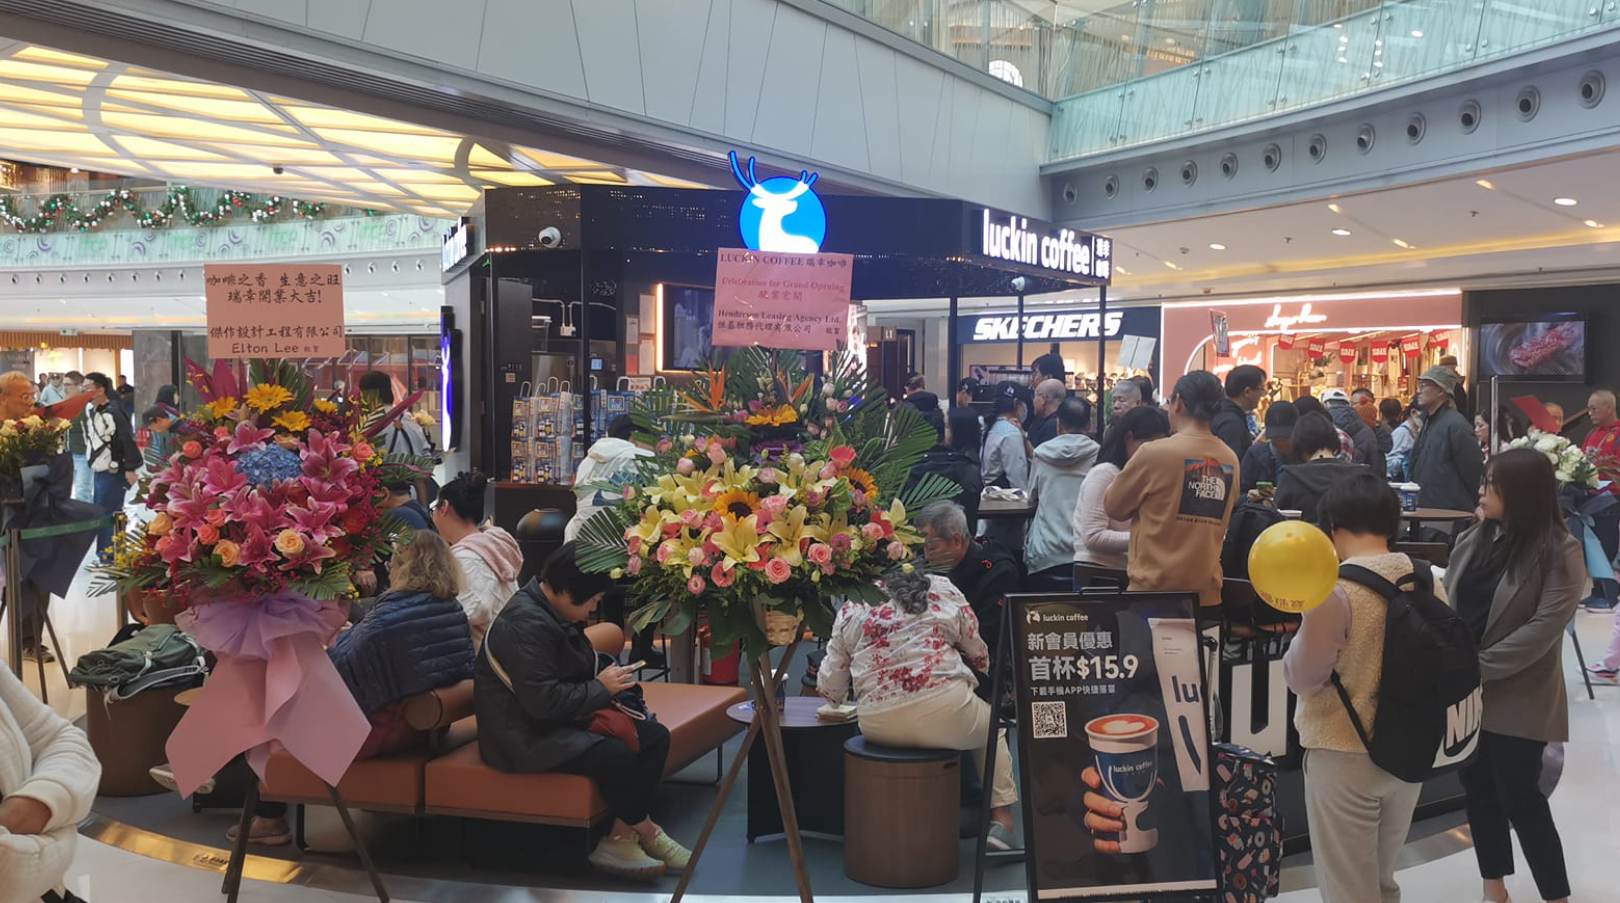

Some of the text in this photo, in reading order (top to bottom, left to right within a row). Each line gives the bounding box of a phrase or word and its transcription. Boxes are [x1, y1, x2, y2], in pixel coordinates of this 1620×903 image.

[983, 208, 1090, 275] luckin coffee
[762, 256, 805, 267] COFFEE
[206, 272, 341, 287] 咖啡之香 生意之旺
[769, 279, 782, 288] for
[782, 280, 809, 290] Grand
[810, 282, 846, 294] Opening
[227, 288, 323, 304] 瑞幸開業大吉!
[718, 309, 842, 325] Henderson Leasing Agency Ltd.
[210, 325, 343, 340] 傑作設計工程有限公司
[973, 312, 1124, 341] SKECHERS
[231, 343, 268, 354] Elton
[274, 343, 300, 354] Lee
[1188, 481, 1217, 491] NORTH
[1202, 475, 1217, 484] THE
[1196, 490, 1216, 499] FACE
[1043, 613, 1089, 622] luckin coffee
[1027, 631, 1113, 651] 新會員優惠
[1029, 655, 1139, 681] 首杯$15.9
[1113, 764, 1134, 773] luckin
